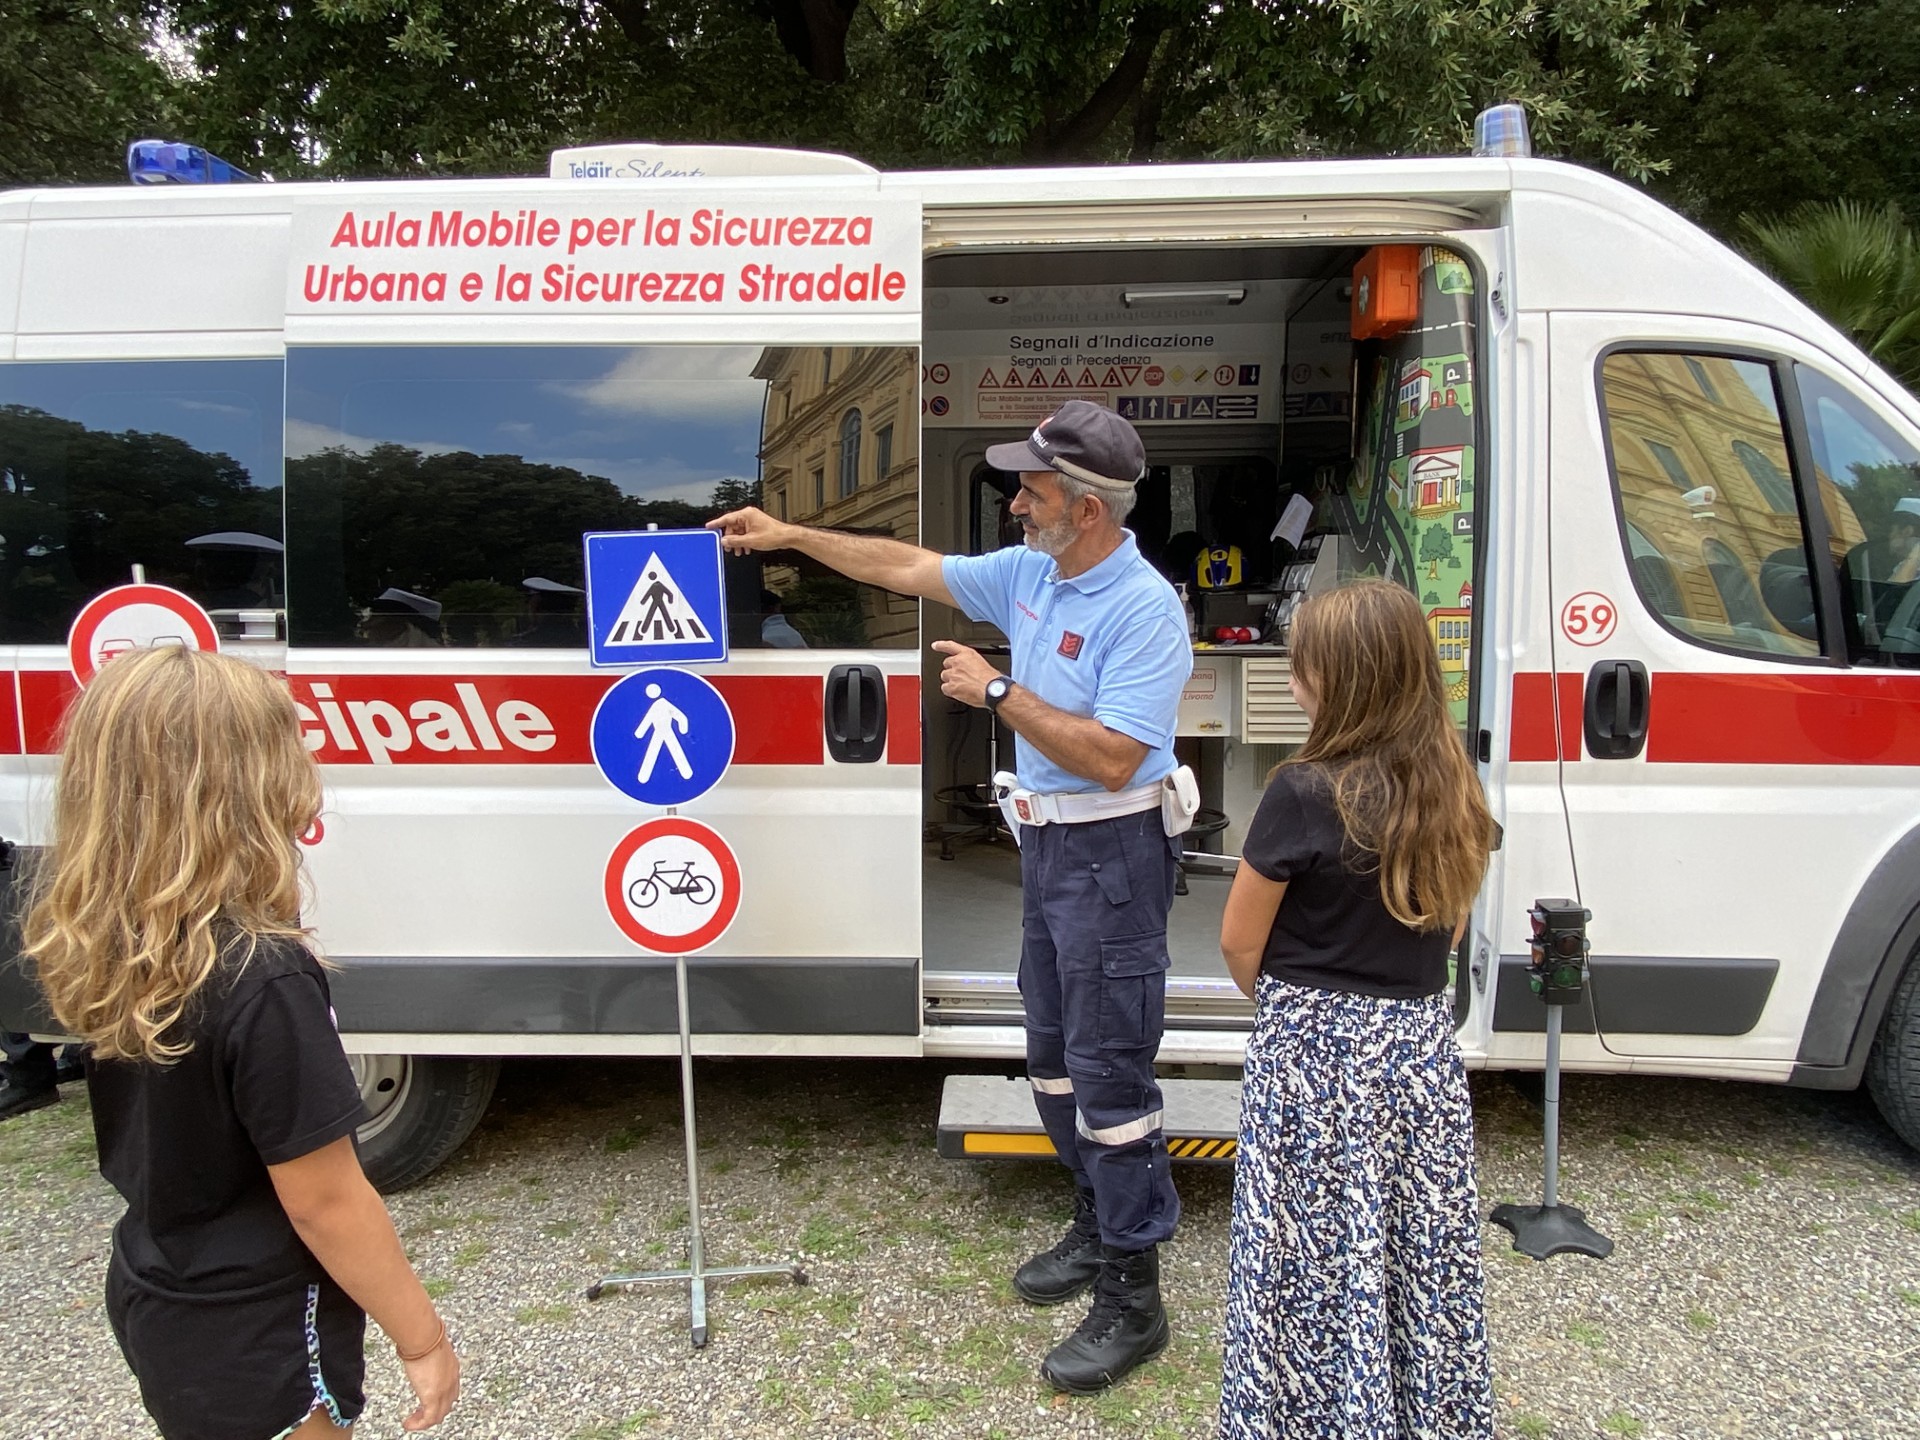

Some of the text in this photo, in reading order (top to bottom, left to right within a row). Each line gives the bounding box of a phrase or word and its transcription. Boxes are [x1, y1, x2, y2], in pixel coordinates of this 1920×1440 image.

[331, 209, 873, 256] Aula Mobile per la Sicurezza
[304, 263, 906, 304] Urbana e la Sicurezza Stradale
[1010, 334, 1214, 352] Segnali d'Indicazione
[1010, 354, 1152, 369] Segnali di Precedenza
[1144, 371, 1163, 381] STOP
[1567, 604, 1613, 635] 59
[1192, 672, 1213, 680] bana
[1183, 693, 1214, 701] Livorno
[297, 682, 557, 764] cipale
